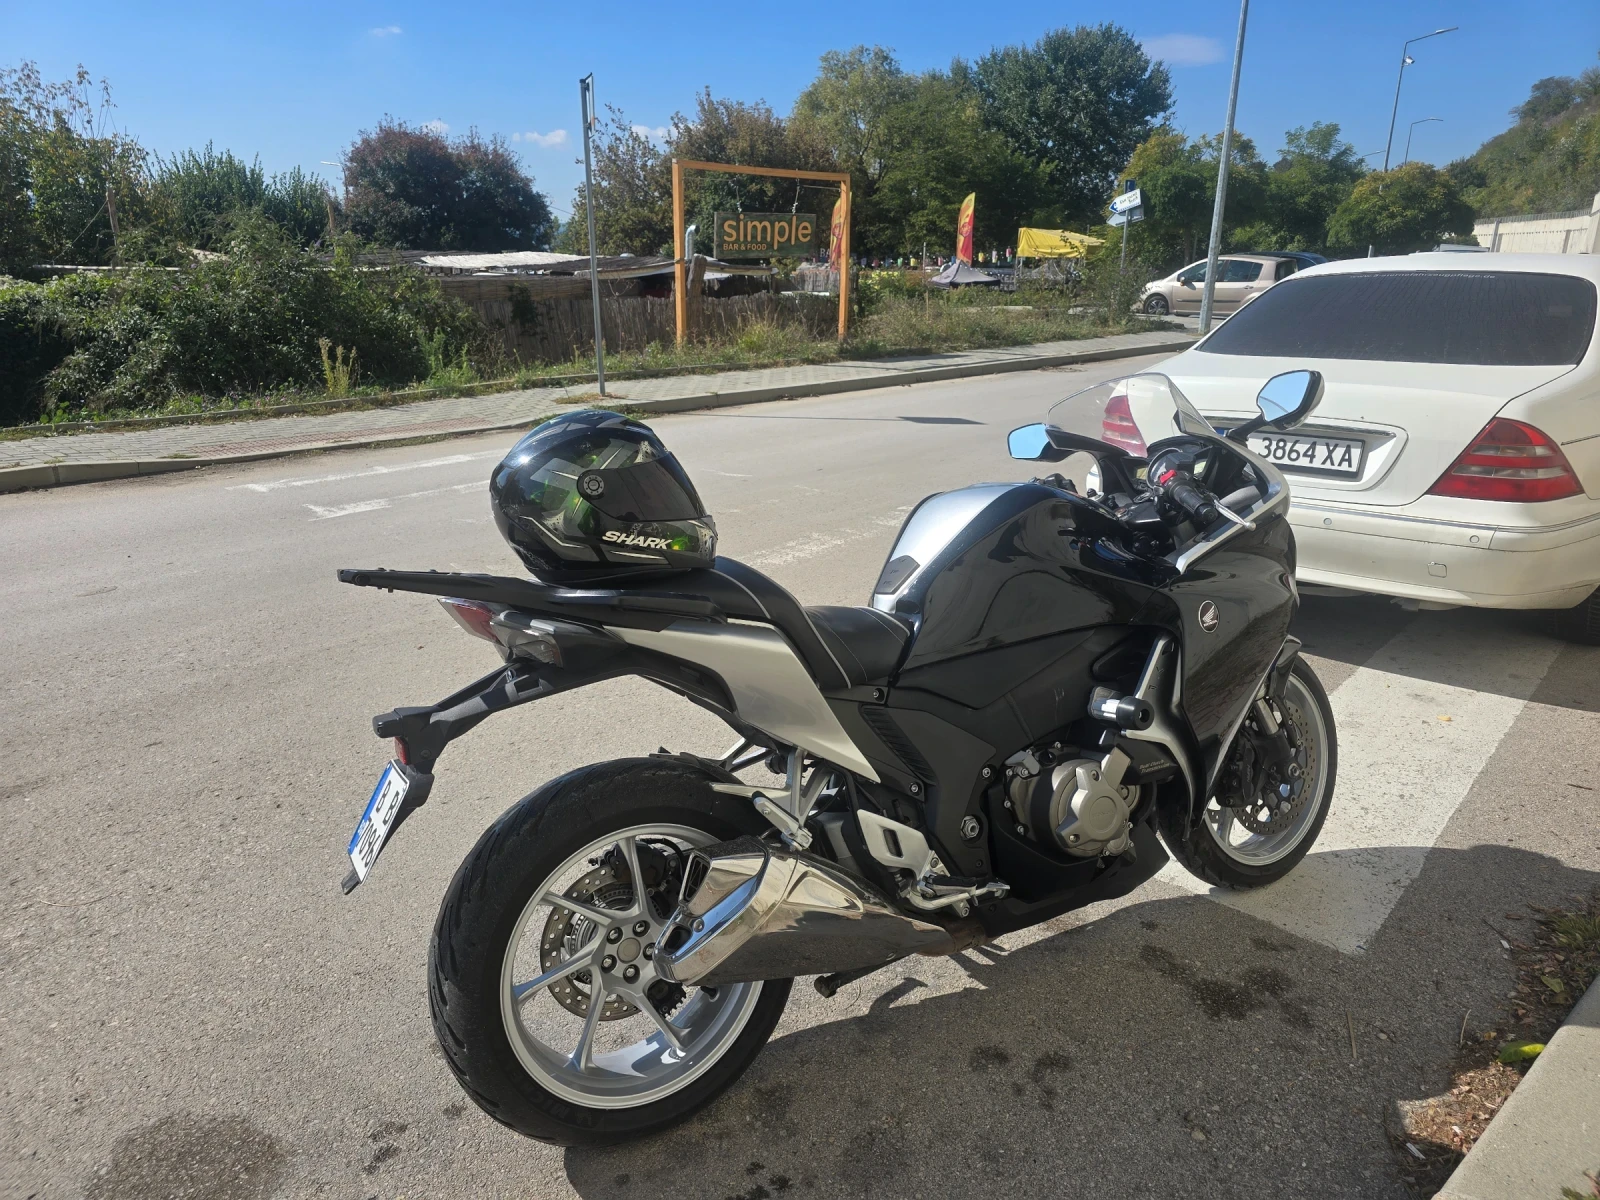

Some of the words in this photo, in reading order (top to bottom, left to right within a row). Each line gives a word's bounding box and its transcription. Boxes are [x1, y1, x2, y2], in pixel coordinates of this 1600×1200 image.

[723, 213, 812, 251] simple
[723, 243, 739, 251] BAR
[740, 243, 746, 251] &
[747, 243, 767, 251] FOOD
[1258, 436, 1318, 465] 3864
[1320, 442, 1353, 468] XA
[601, 530, 673, 550] SHARK
